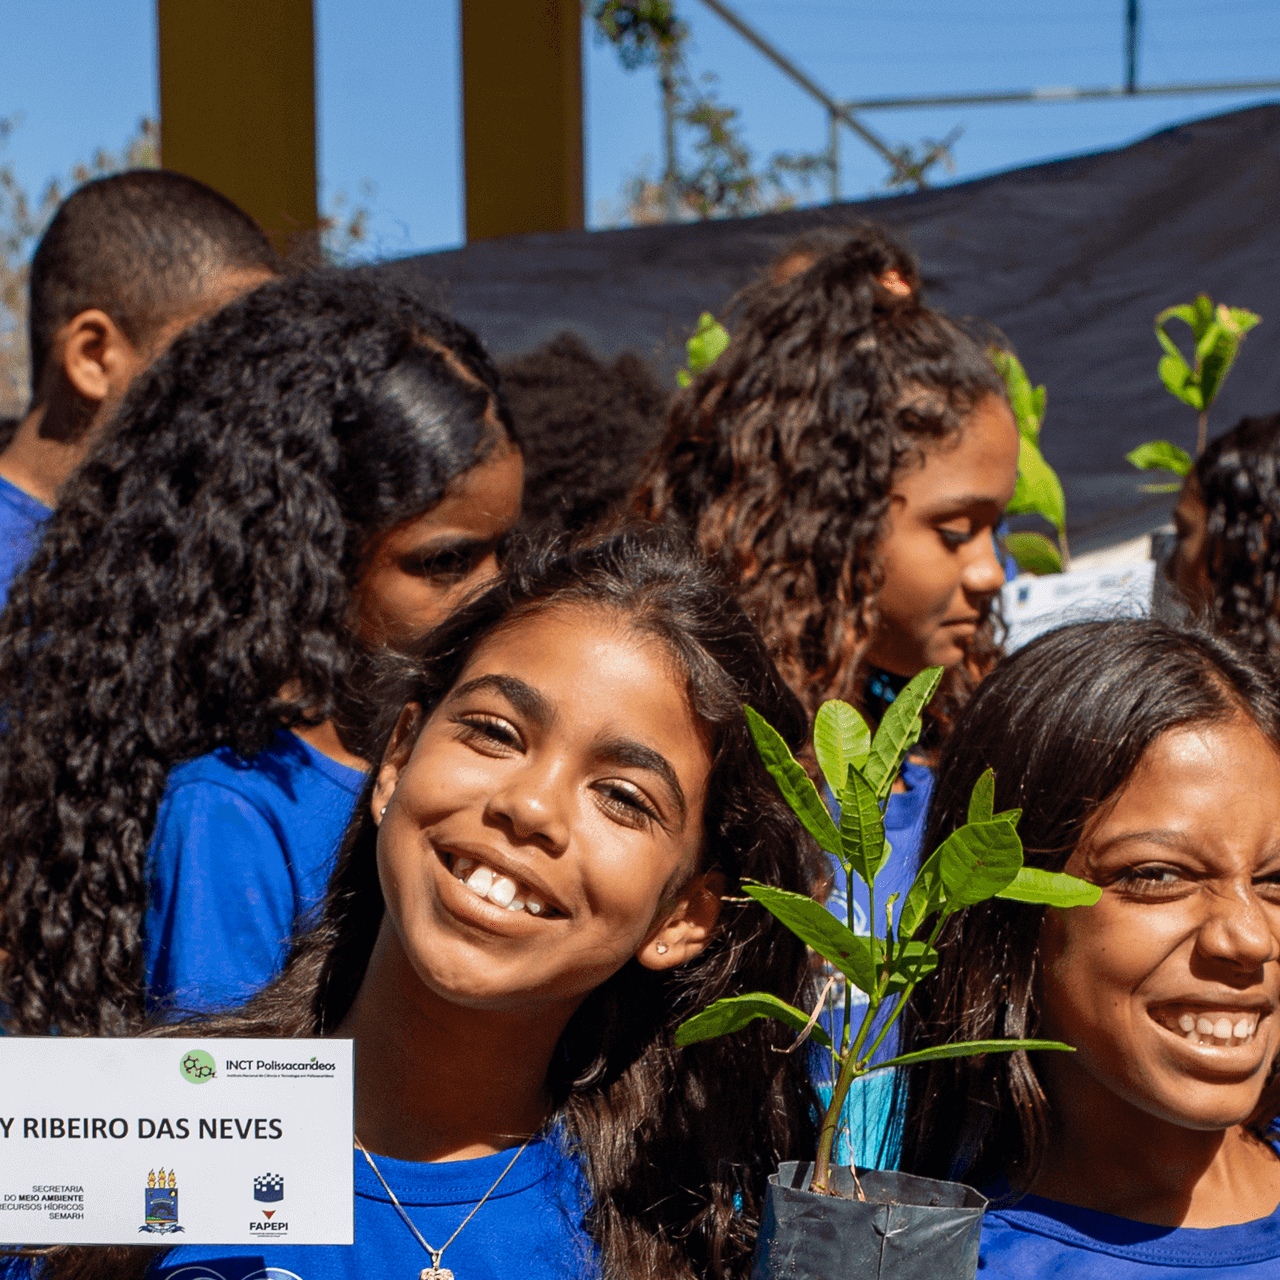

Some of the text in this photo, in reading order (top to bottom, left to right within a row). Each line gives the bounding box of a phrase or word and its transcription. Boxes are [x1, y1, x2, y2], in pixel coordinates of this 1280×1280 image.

[225, 1060, 254, 1071] INCT
[23, 1117, 129, 1139] RIBEIRO
[138, 1117, 190, 1140] DAS
[199, 1117, 283, 1140] NEVES
[32, 1185, 84, 1193] SECRETARIA
[4, 1194, 84, 1202] DO MEIO AMBIENTE
[49, 1212, 84, 1220] SEMARH
[249, 1222, 289, 1231] FAPEPI
